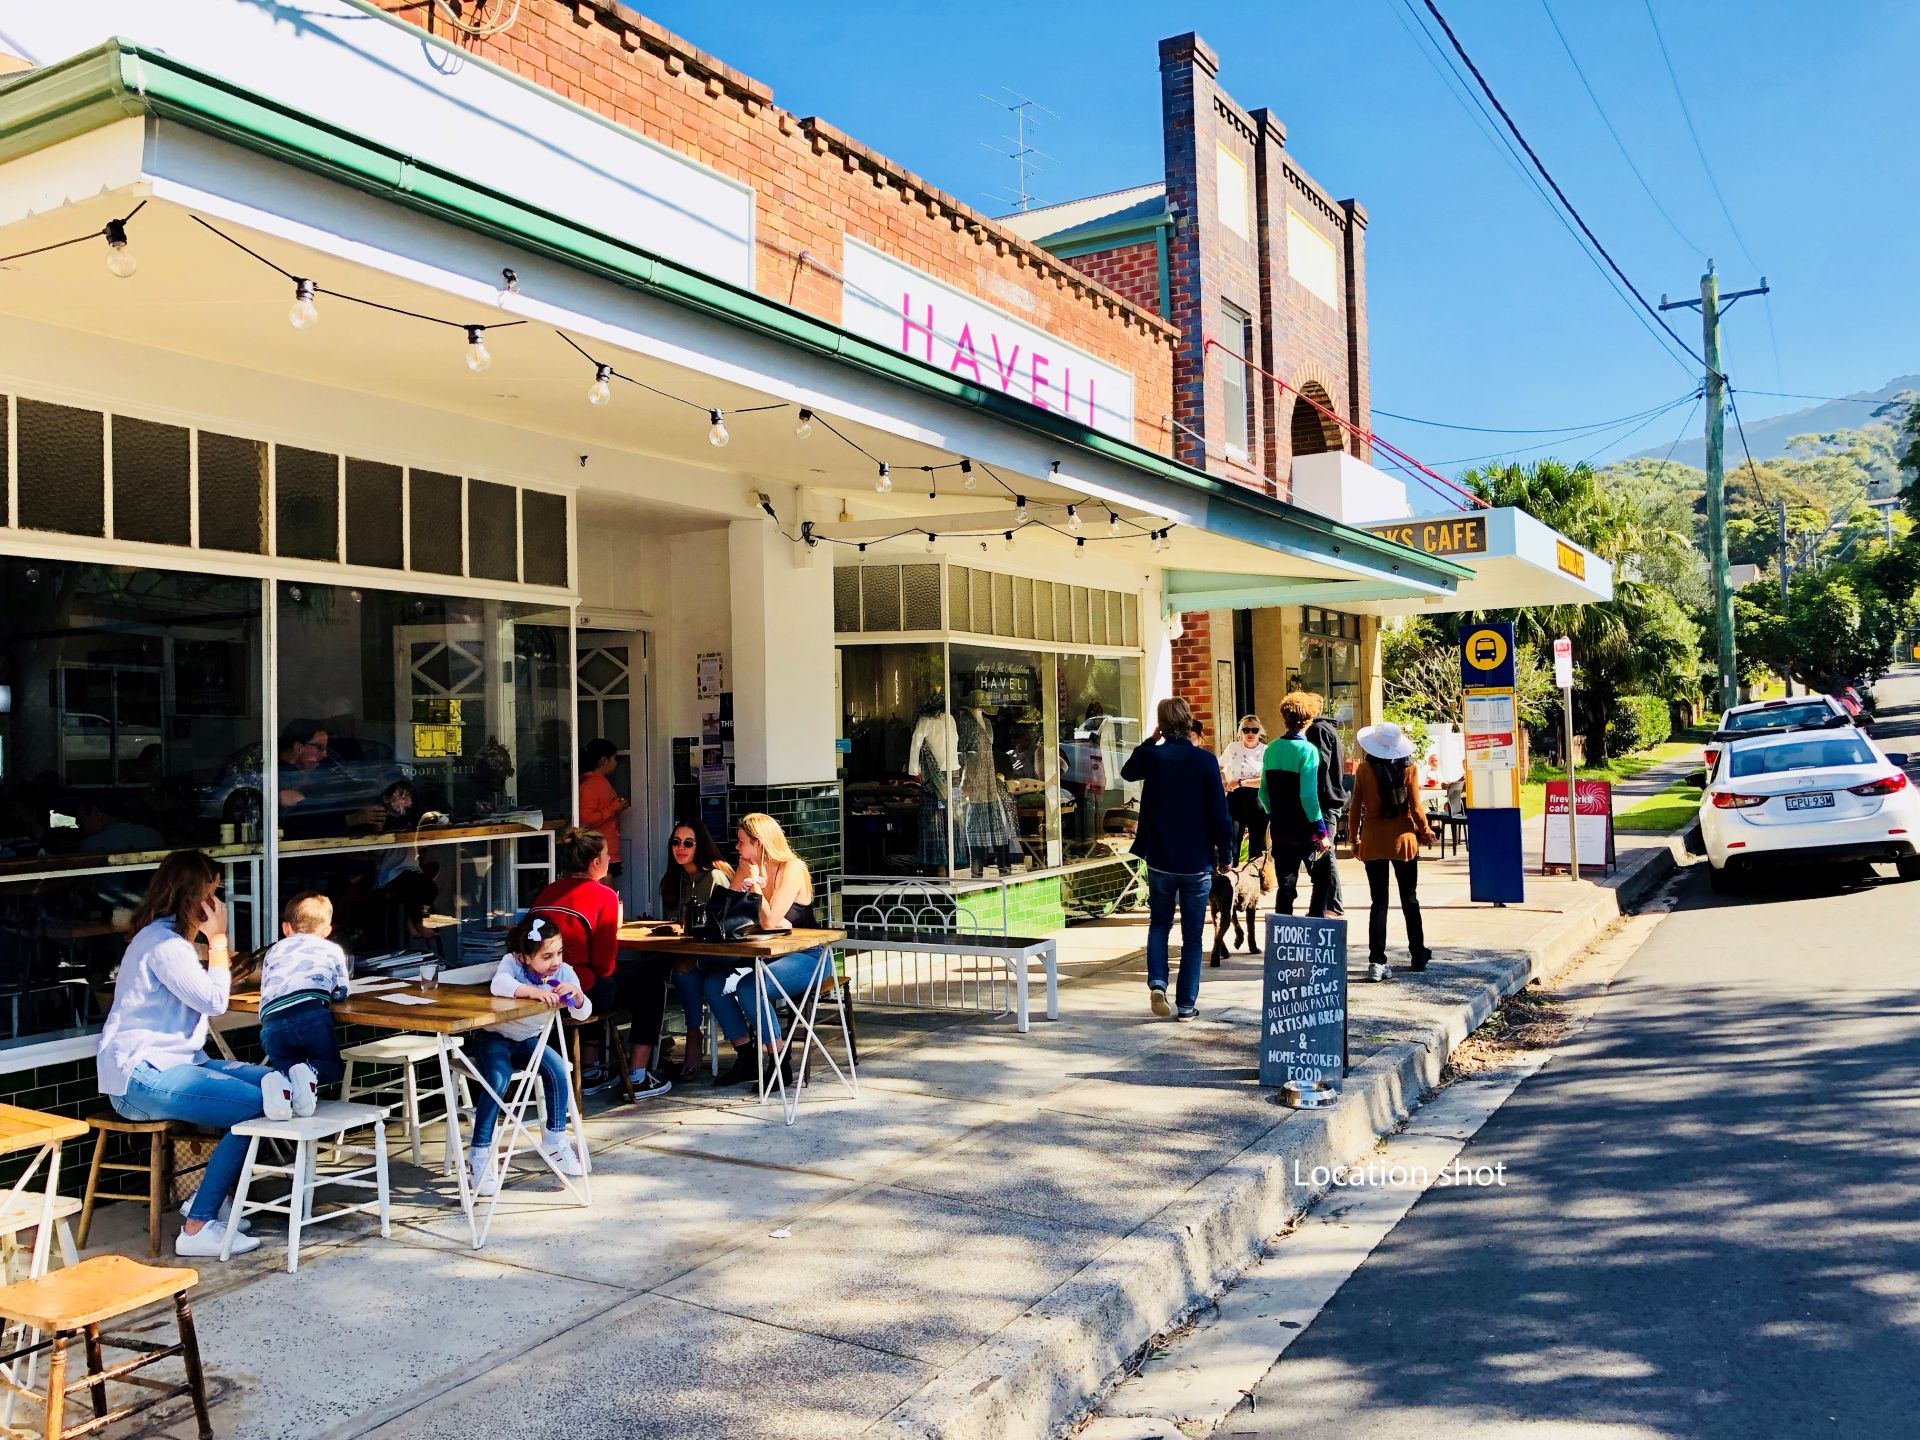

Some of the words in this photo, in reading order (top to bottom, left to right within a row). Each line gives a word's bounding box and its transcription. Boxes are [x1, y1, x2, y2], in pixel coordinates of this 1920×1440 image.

[902, 292, 1095, 428] HAVELI
[1423, 521, 1478, 553] CAFE
[980, 676, 1028, 691] HAVELI
[720, 720, 734, 728] THE
[1549, 804, 1569, 812] cafe
[1273, 925, 1312, 945] MOORE
[1318, 928, 1336, 948] ST.
[1276, 945, 1338, 965] GENERAL
[1277, 967, 1306, 984] open
[1309, 964, 1329, 985] for
[1271, 986, 1298, 1003] HOT
[1300, 979, 1339, 998] BREWS
[1268, 999, 1309, 1019] DELICIOUS
[1310, 993, 1341, 1010] PASTRY
[1269, 1013, 1317, 1036] ARTISAN
[1317, 1008, 1345, 1026] BREAD
[1268, 1049, 1341, 1068] HOME-COOKED
[1287, 1065, 1323, 1082] FOOD
